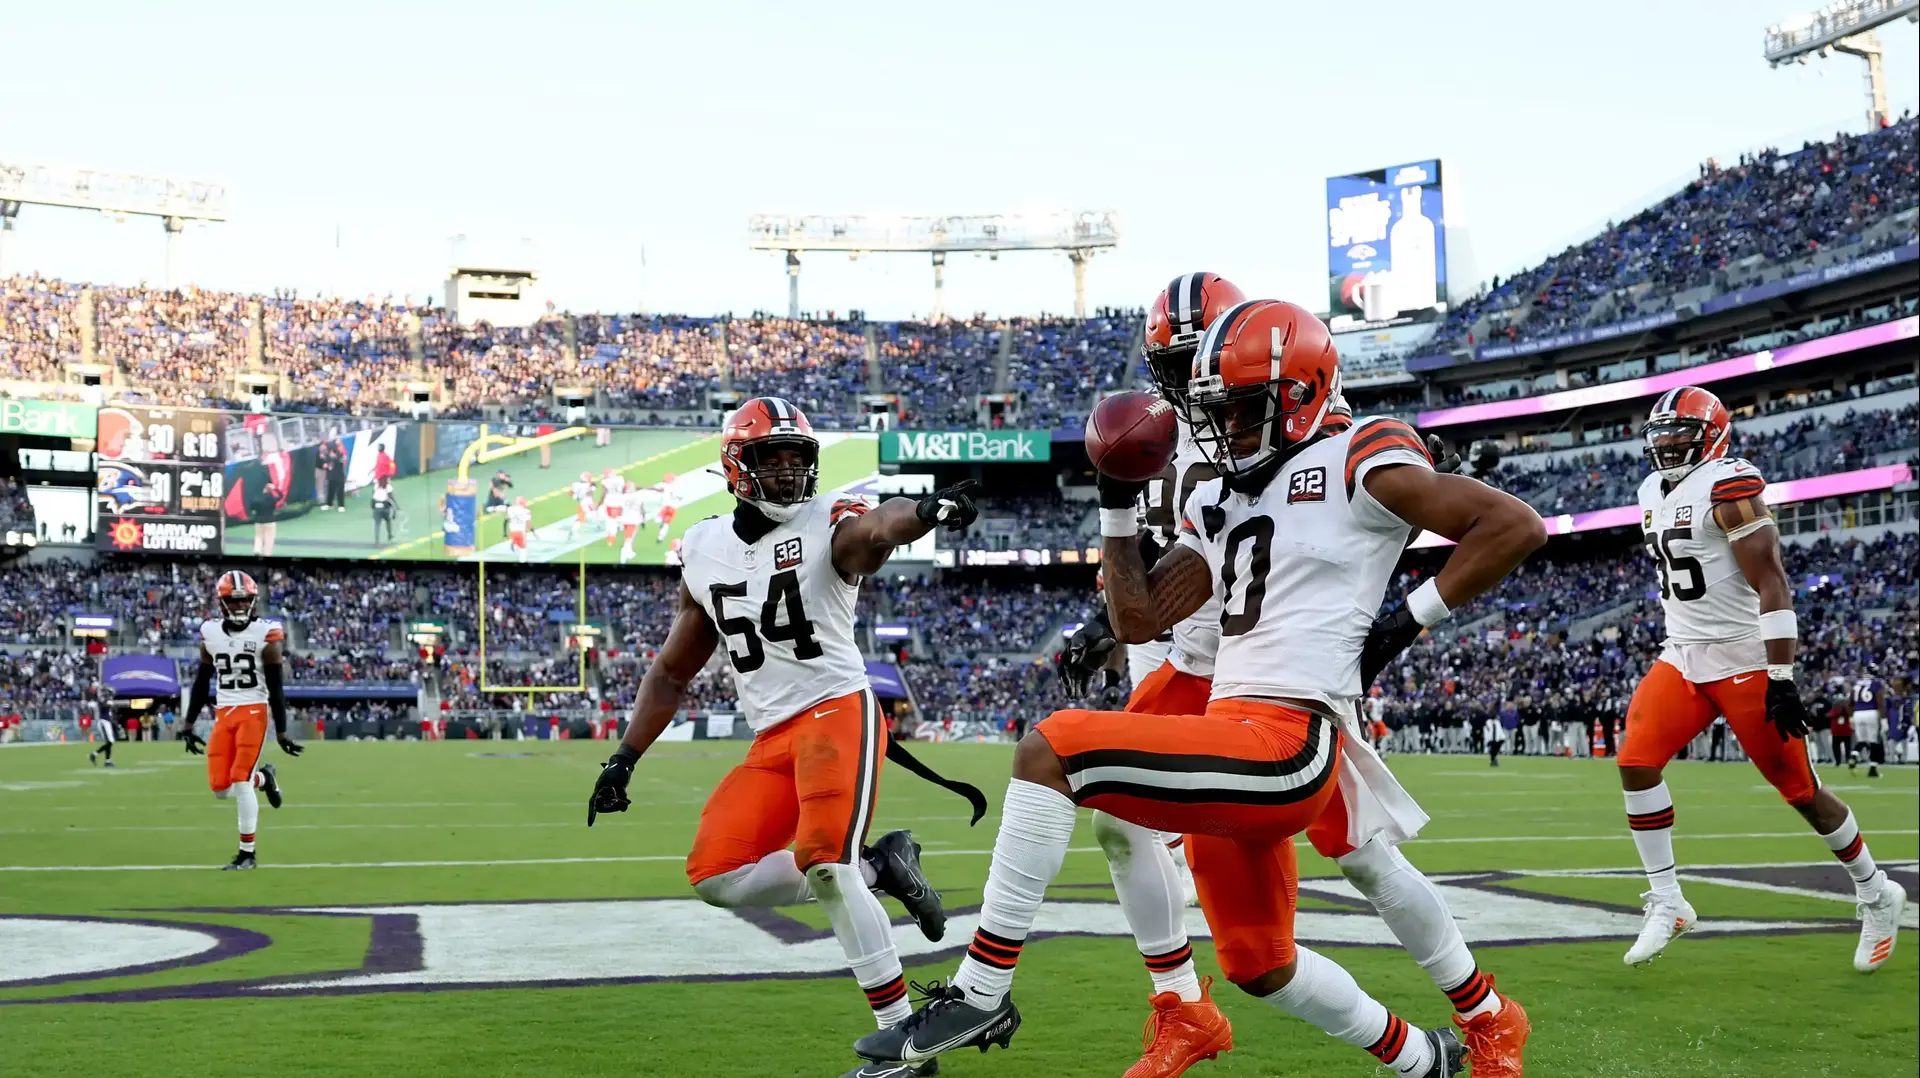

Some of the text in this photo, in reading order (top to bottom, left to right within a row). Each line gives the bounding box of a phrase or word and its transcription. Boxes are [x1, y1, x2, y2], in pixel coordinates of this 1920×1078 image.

[3, 400, 78, 433] Bank
[148, 424, 174, 453] 30
[897, 432, 1035, 460] M&T Bank
[150, 472, 171, 503] 31
[1291, 470, 1323, 495] 32
[1675, 507, 1691, 521] 32
[143, 523, 218, 539] MARYLAND
[776, 540, 801, 562] 32
[1220, 515, 1275, 636] 0
[709, 569, 824, 673] 54
[215, 653, 258, 689] 23
